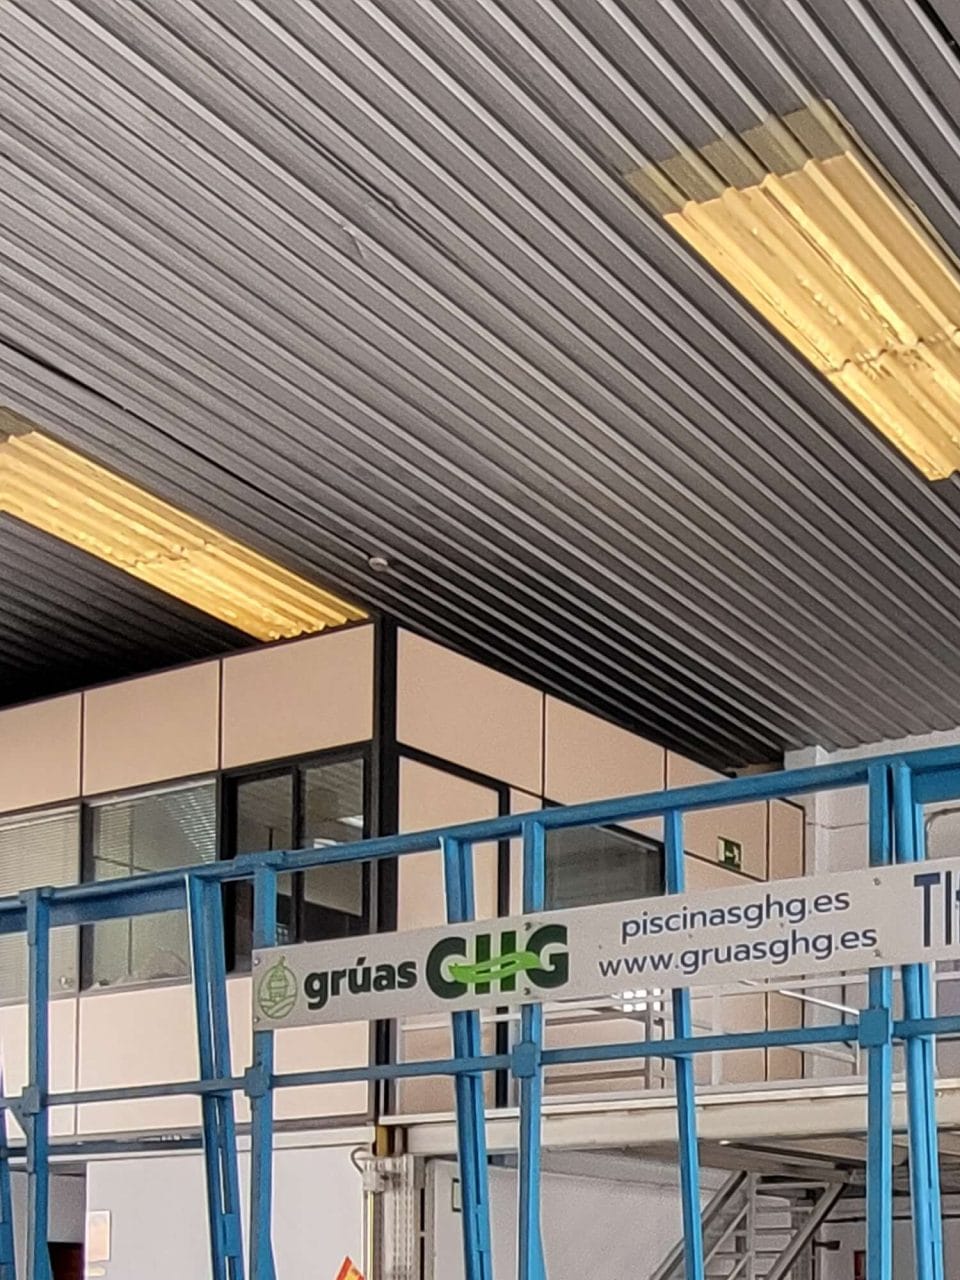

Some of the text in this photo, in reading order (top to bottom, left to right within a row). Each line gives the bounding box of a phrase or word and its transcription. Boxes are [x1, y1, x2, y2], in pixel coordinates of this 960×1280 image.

[621, 891, 850, 944] piscinasghg.es
[598, 928, 877, 977] www.gruasghg.es
[304, 957, 418, 1010] grúas
